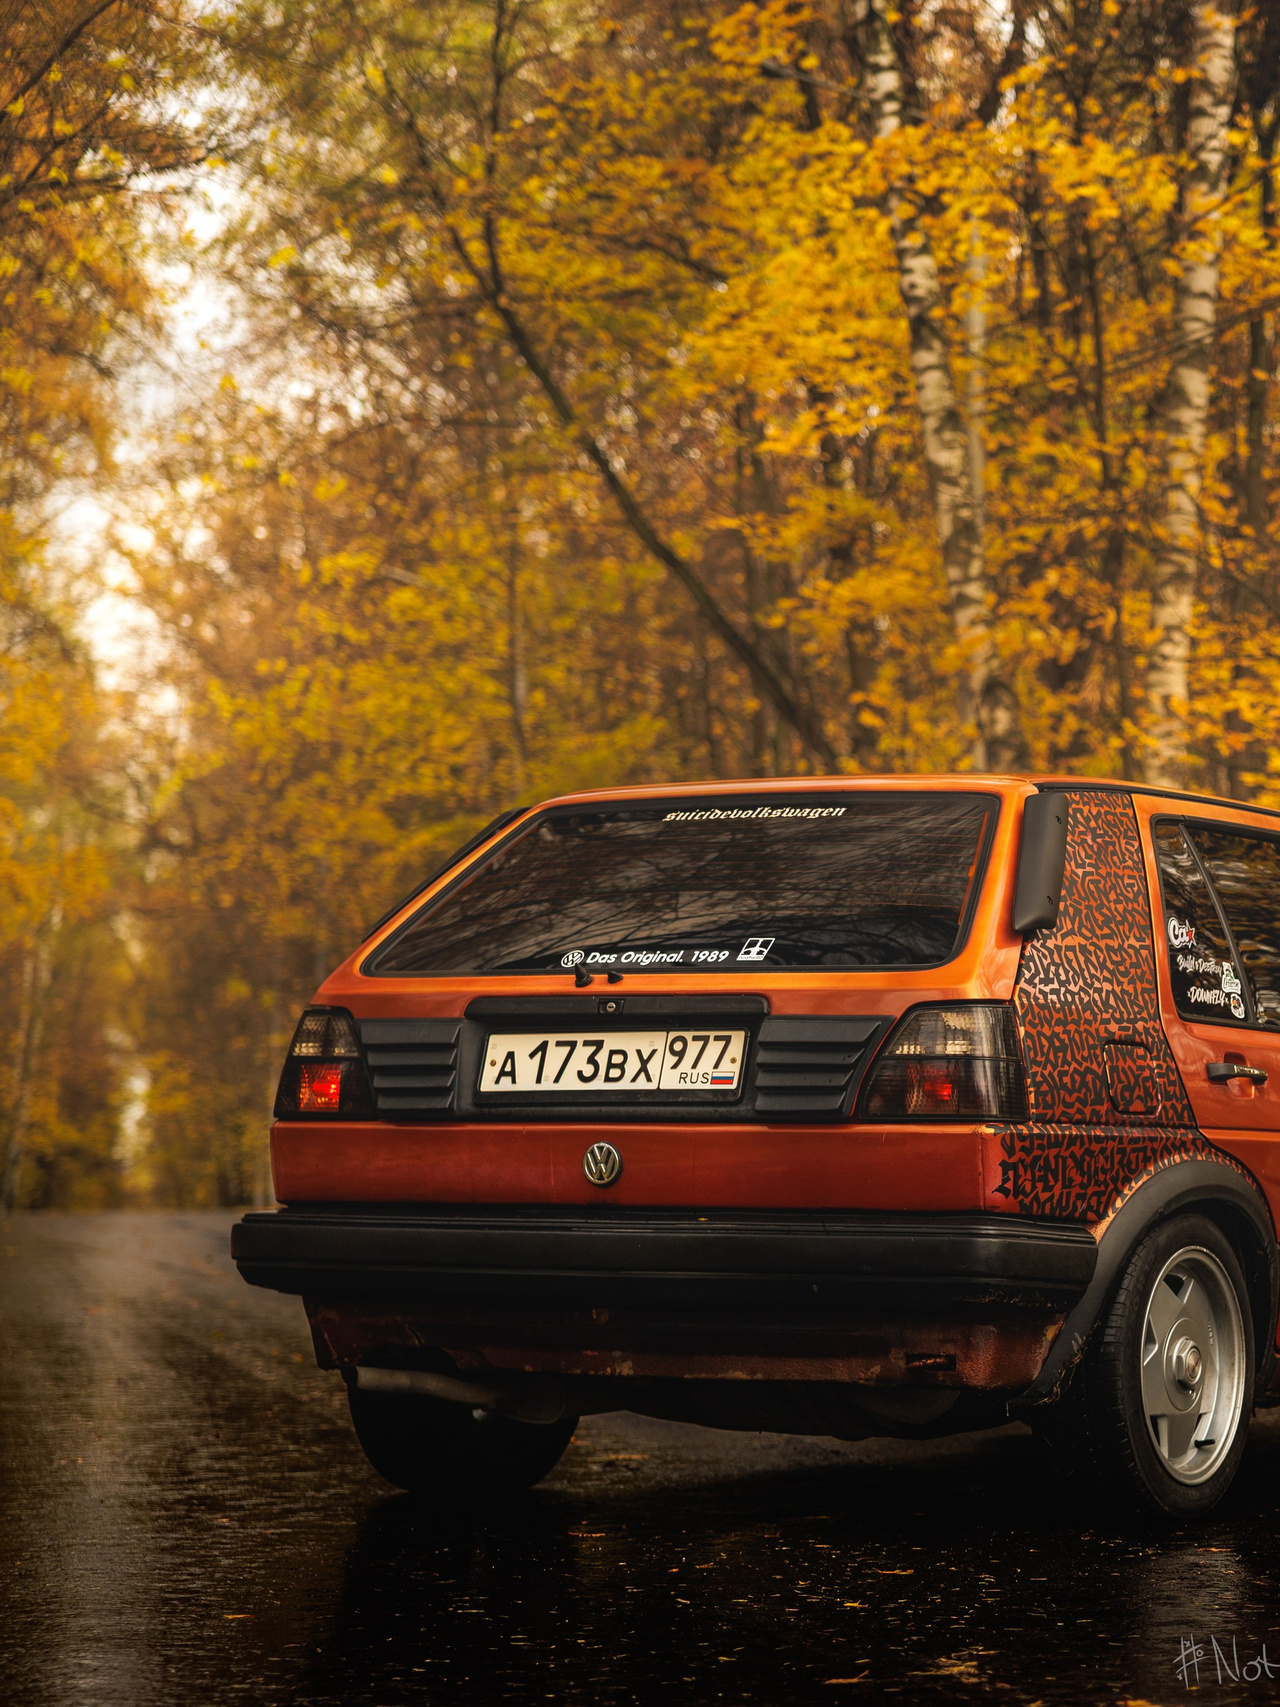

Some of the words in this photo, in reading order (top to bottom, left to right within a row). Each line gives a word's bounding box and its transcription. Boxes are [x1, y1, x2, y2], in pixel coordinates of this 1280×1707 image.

[662, 806, 847, 822] suicidevolkswagen
[586, 951, 617, 964] Das
[620, 950, 684, 966] Original.
[691, 950, 729, 963] 1989
[668, 1034, 733, 1070] 977
[678, 1071, 710, 1084] RUS
[583, 1141, 622, 1185] VW
